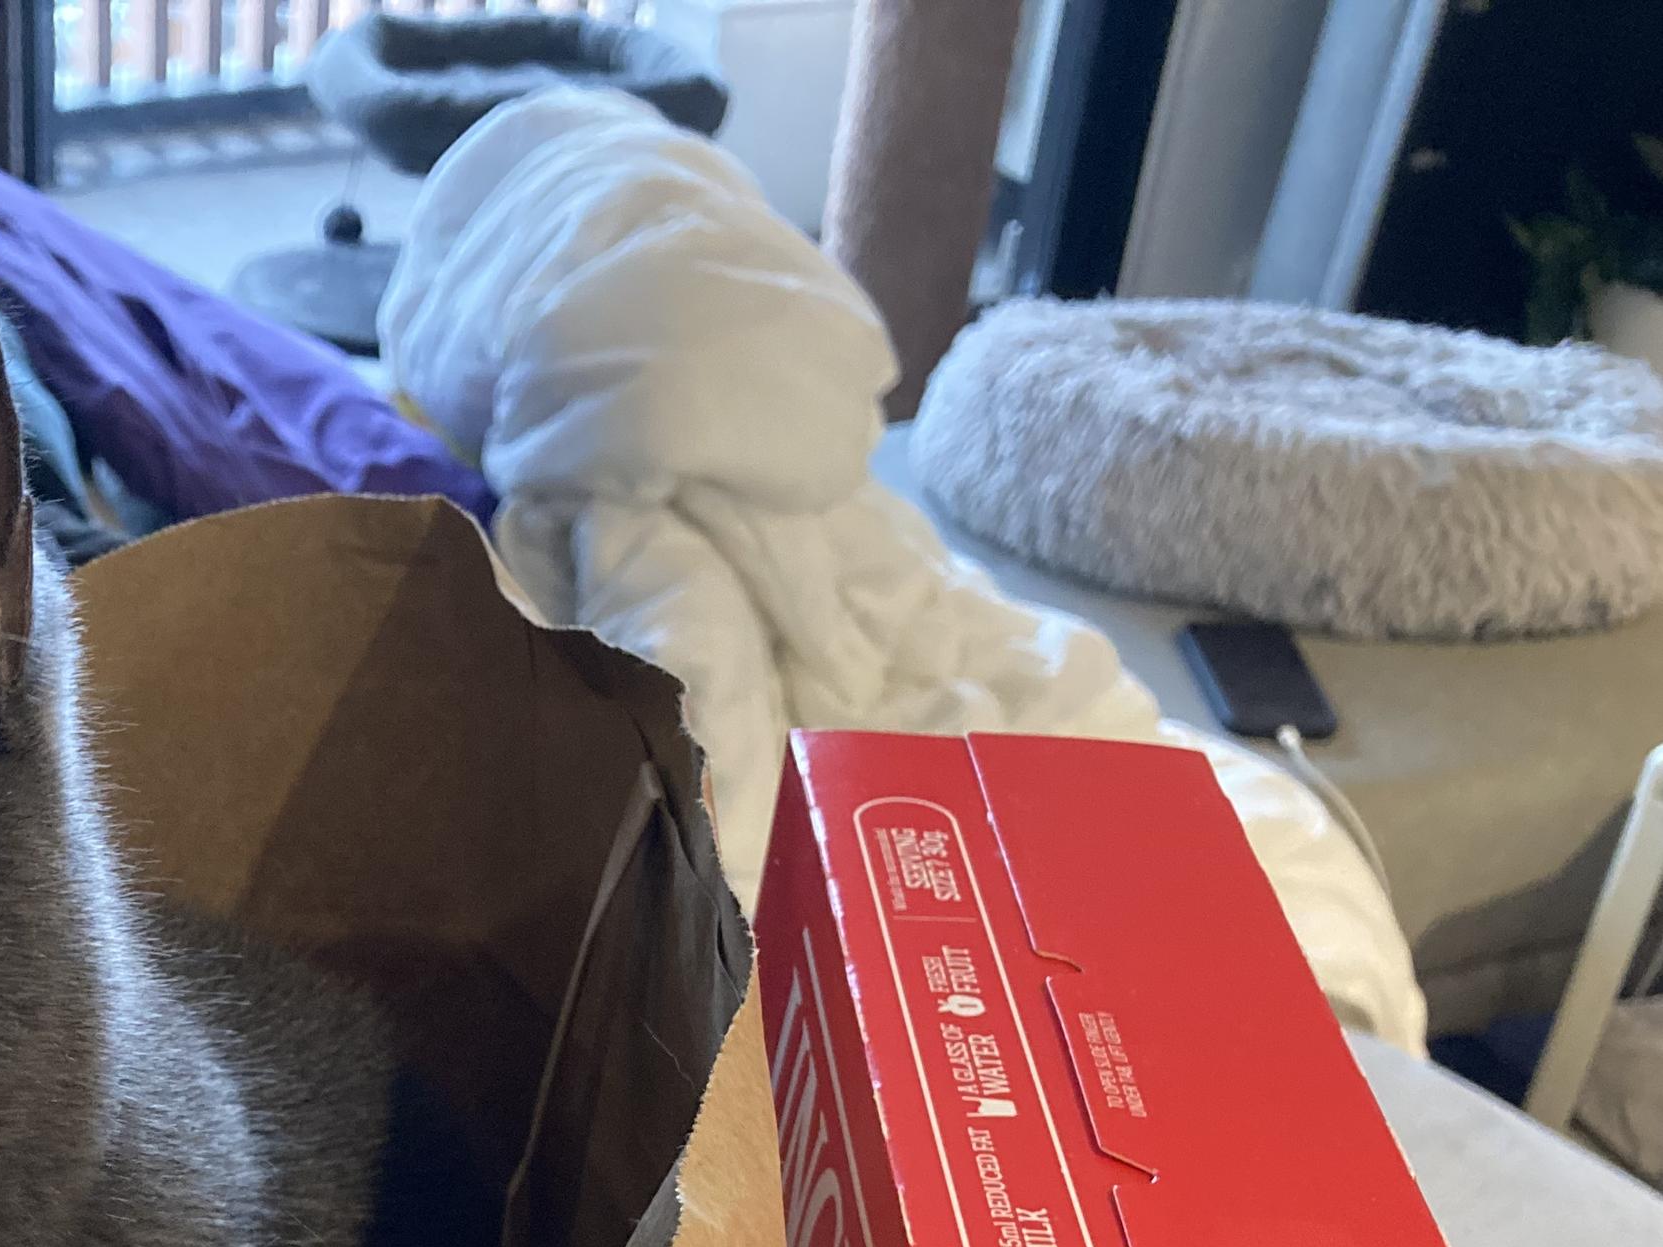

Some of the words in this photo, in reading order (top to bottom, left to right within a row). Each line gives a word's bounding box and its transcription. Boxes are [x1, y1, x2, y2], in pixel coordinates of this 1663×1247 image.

[890, 827, 932, 889] SERVING
[921, 956, 950, 993] FRESH
[942, 945, 981, 994] FRUIT
[940, 1022, 964, 1041] OF
[945, 1042, 975, 1083] GLASS
[968, 1034, 1011, 1096] WATER
[1099, 1069, 1120, 1095] OPEN
[957, 1082, 979, 1094] A
[967, 1126, 995, 1152] FAT
[976, 1153, 1014, 1219] REDUCED
